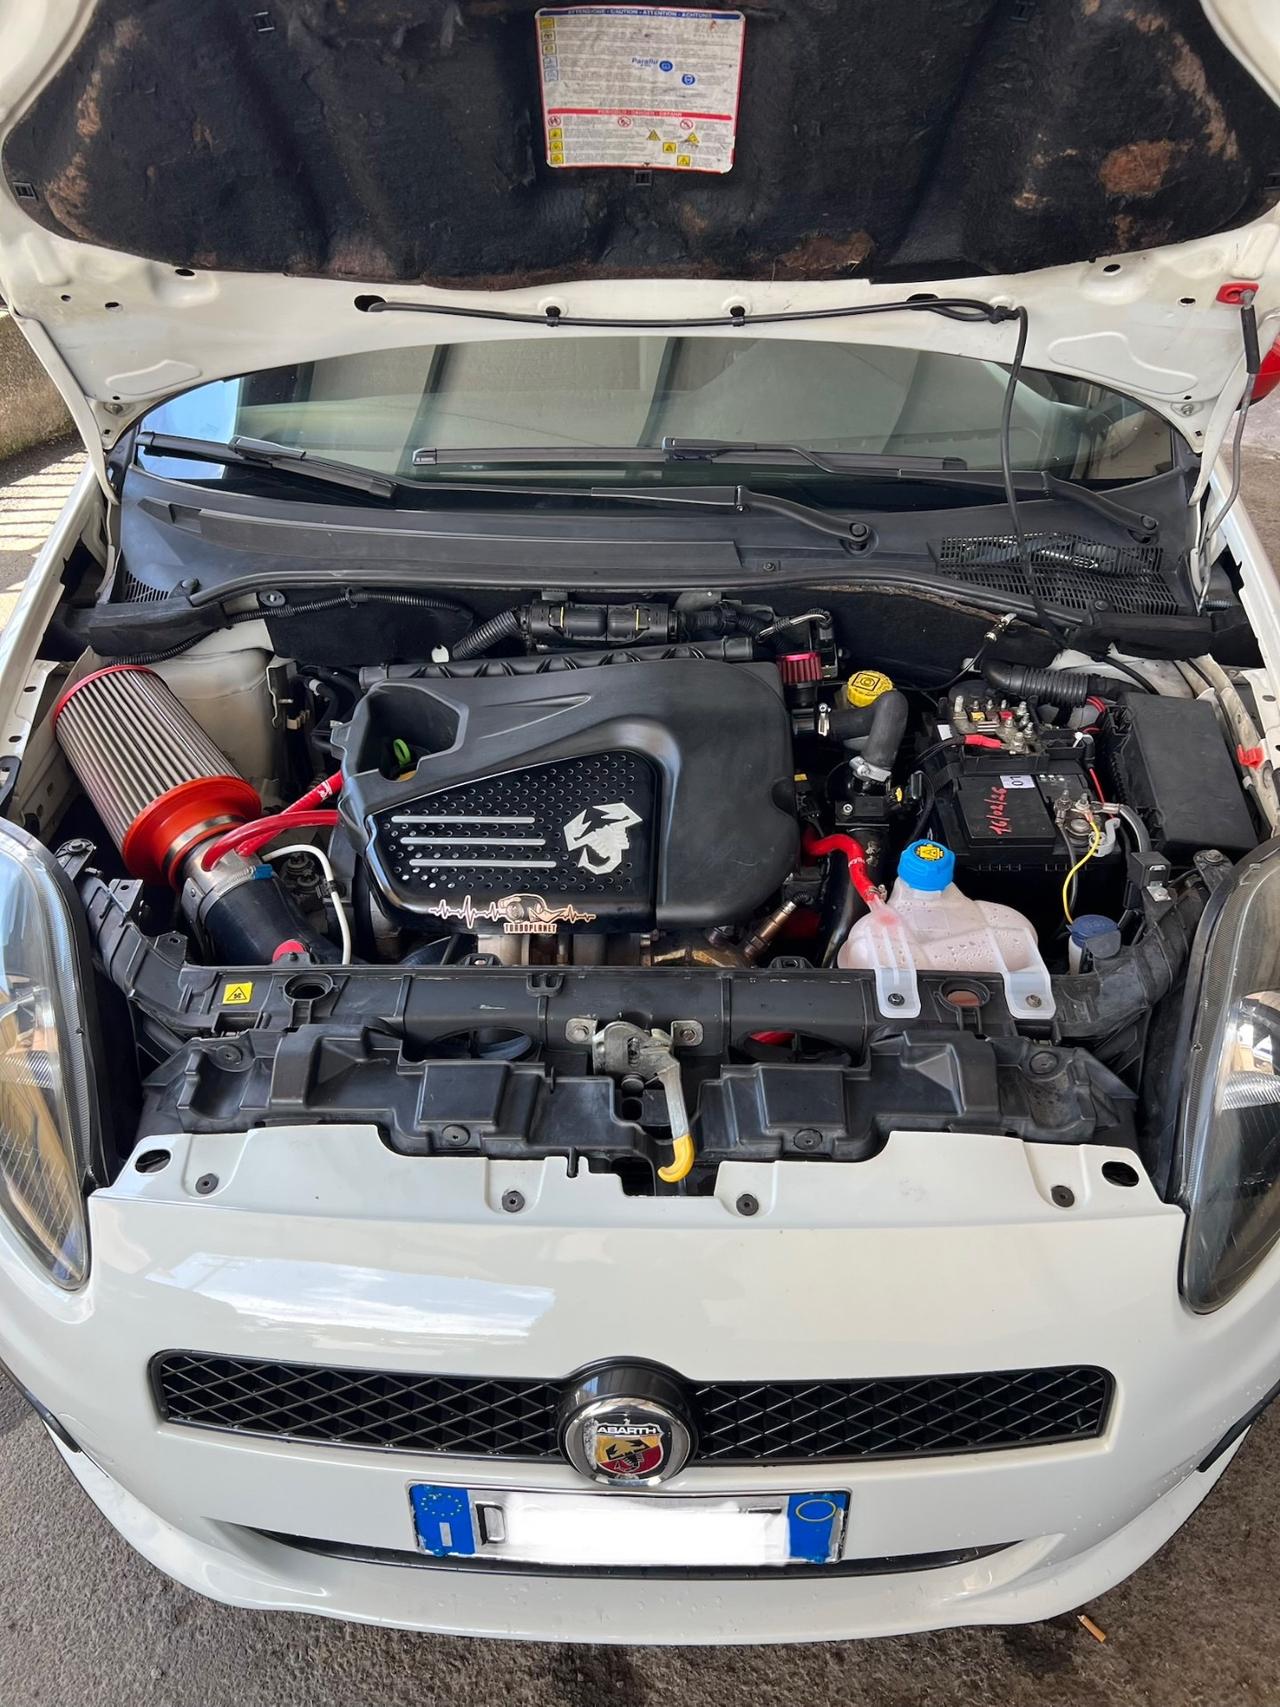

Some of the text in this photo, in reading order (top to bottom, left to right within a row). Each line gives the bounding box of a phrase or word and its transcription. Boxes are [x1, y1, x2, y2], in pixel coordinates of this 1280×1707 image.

[610, 8, 638, 16] CAUTION
[643, 9, 677, 17] ATTENTION
[597, 1426, 657, 1435] ABARTH
